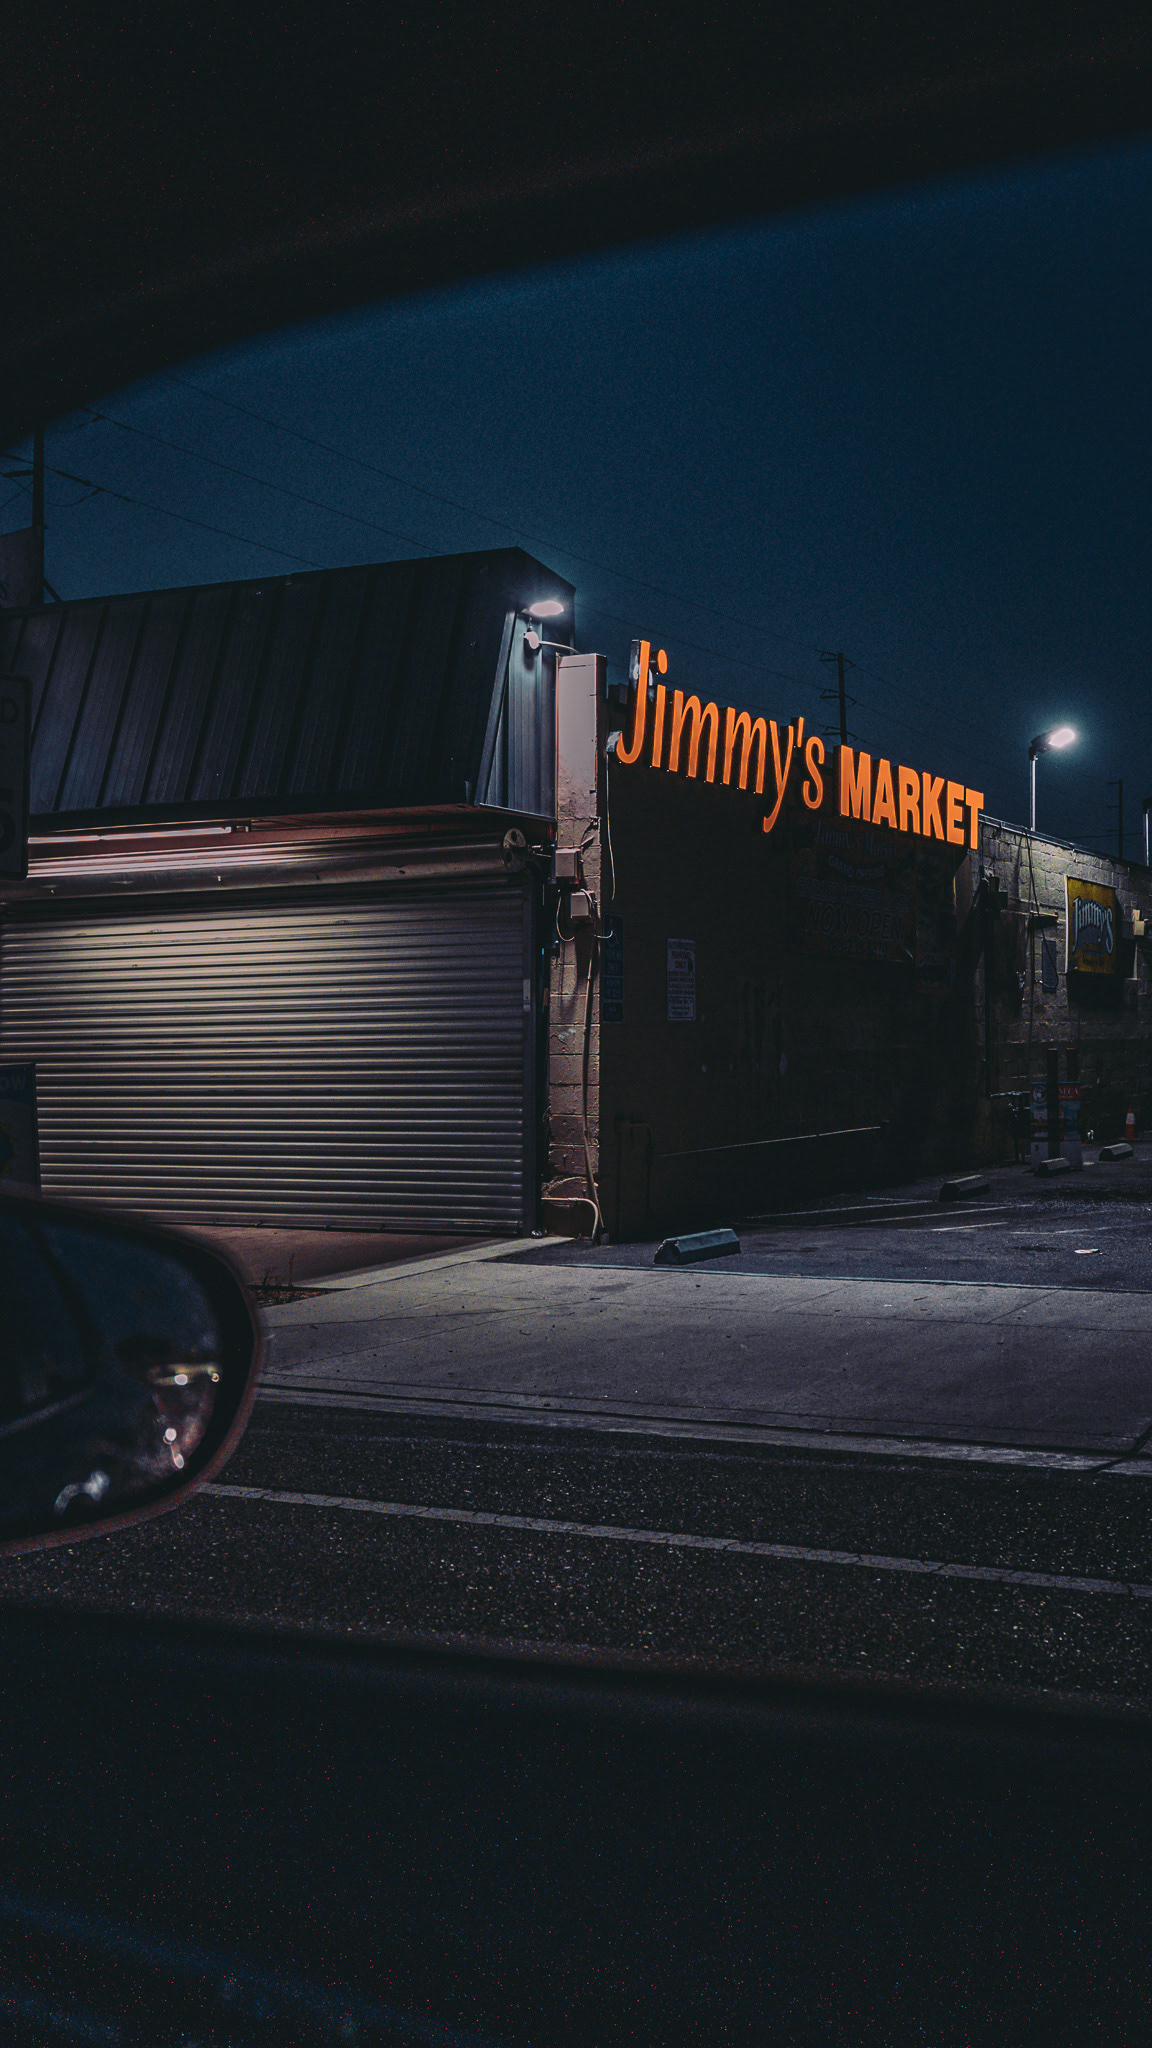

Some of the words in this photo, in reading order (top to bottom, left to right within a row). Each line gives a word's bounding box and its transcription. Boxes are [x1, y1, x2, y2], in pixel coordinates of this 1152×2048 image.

[616, 640, 825, 833] Jimmy's
[841, 744, 985, 849] MARKET
[829, 855, 854, 878] GRAND
[805, 902, 855, 937] NOW
[856, 908, 904, 942] OPEN
